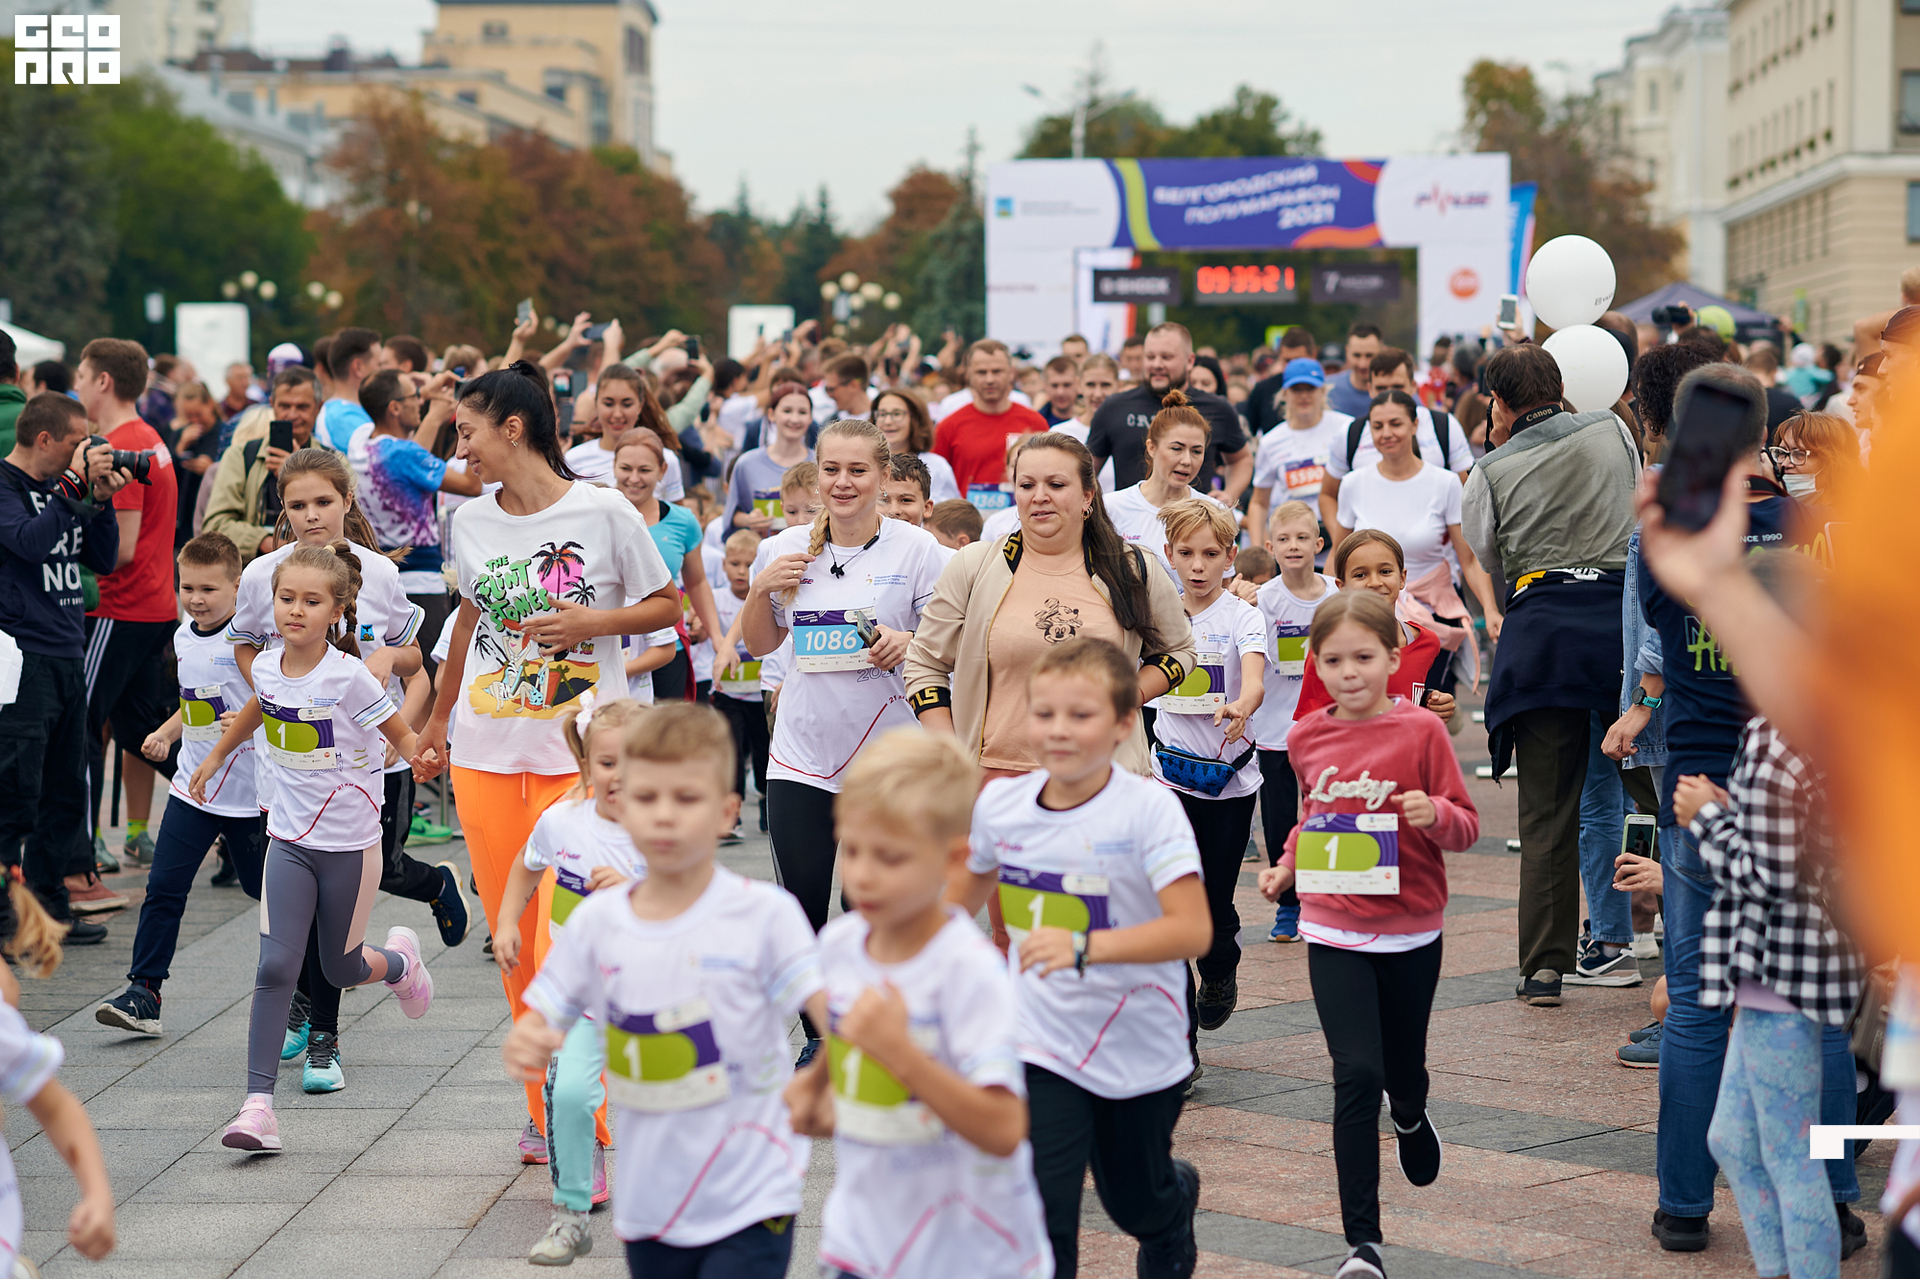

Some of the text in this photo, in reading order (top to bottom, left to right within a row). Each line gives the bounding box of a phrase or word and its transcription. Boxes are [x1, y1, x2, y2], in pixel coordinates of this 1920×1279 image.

[1277, 202, 1335, 230] 2021
[1127, 413, 1156, 429] CR
[1526, 407, 1553, 422] Canon
[766, 500, 775, 518] 1
[973, 494, 1007, 508] 1368
[1762, 532, 1783, 542] 1990
[485, 555, 509, 572] THE
[805, 629, 857, 651] 1086
[737, 663, 745, 682] 1
[185, 702, 192, 725] 1
[277, 723, 286, 749] 1
[1324, 835, 1339, 870] 1
[1027, 893, 1045, 929] 1
[623, 1036, 642, 1081] 1
[842, 1046, 862, 1103] 1
